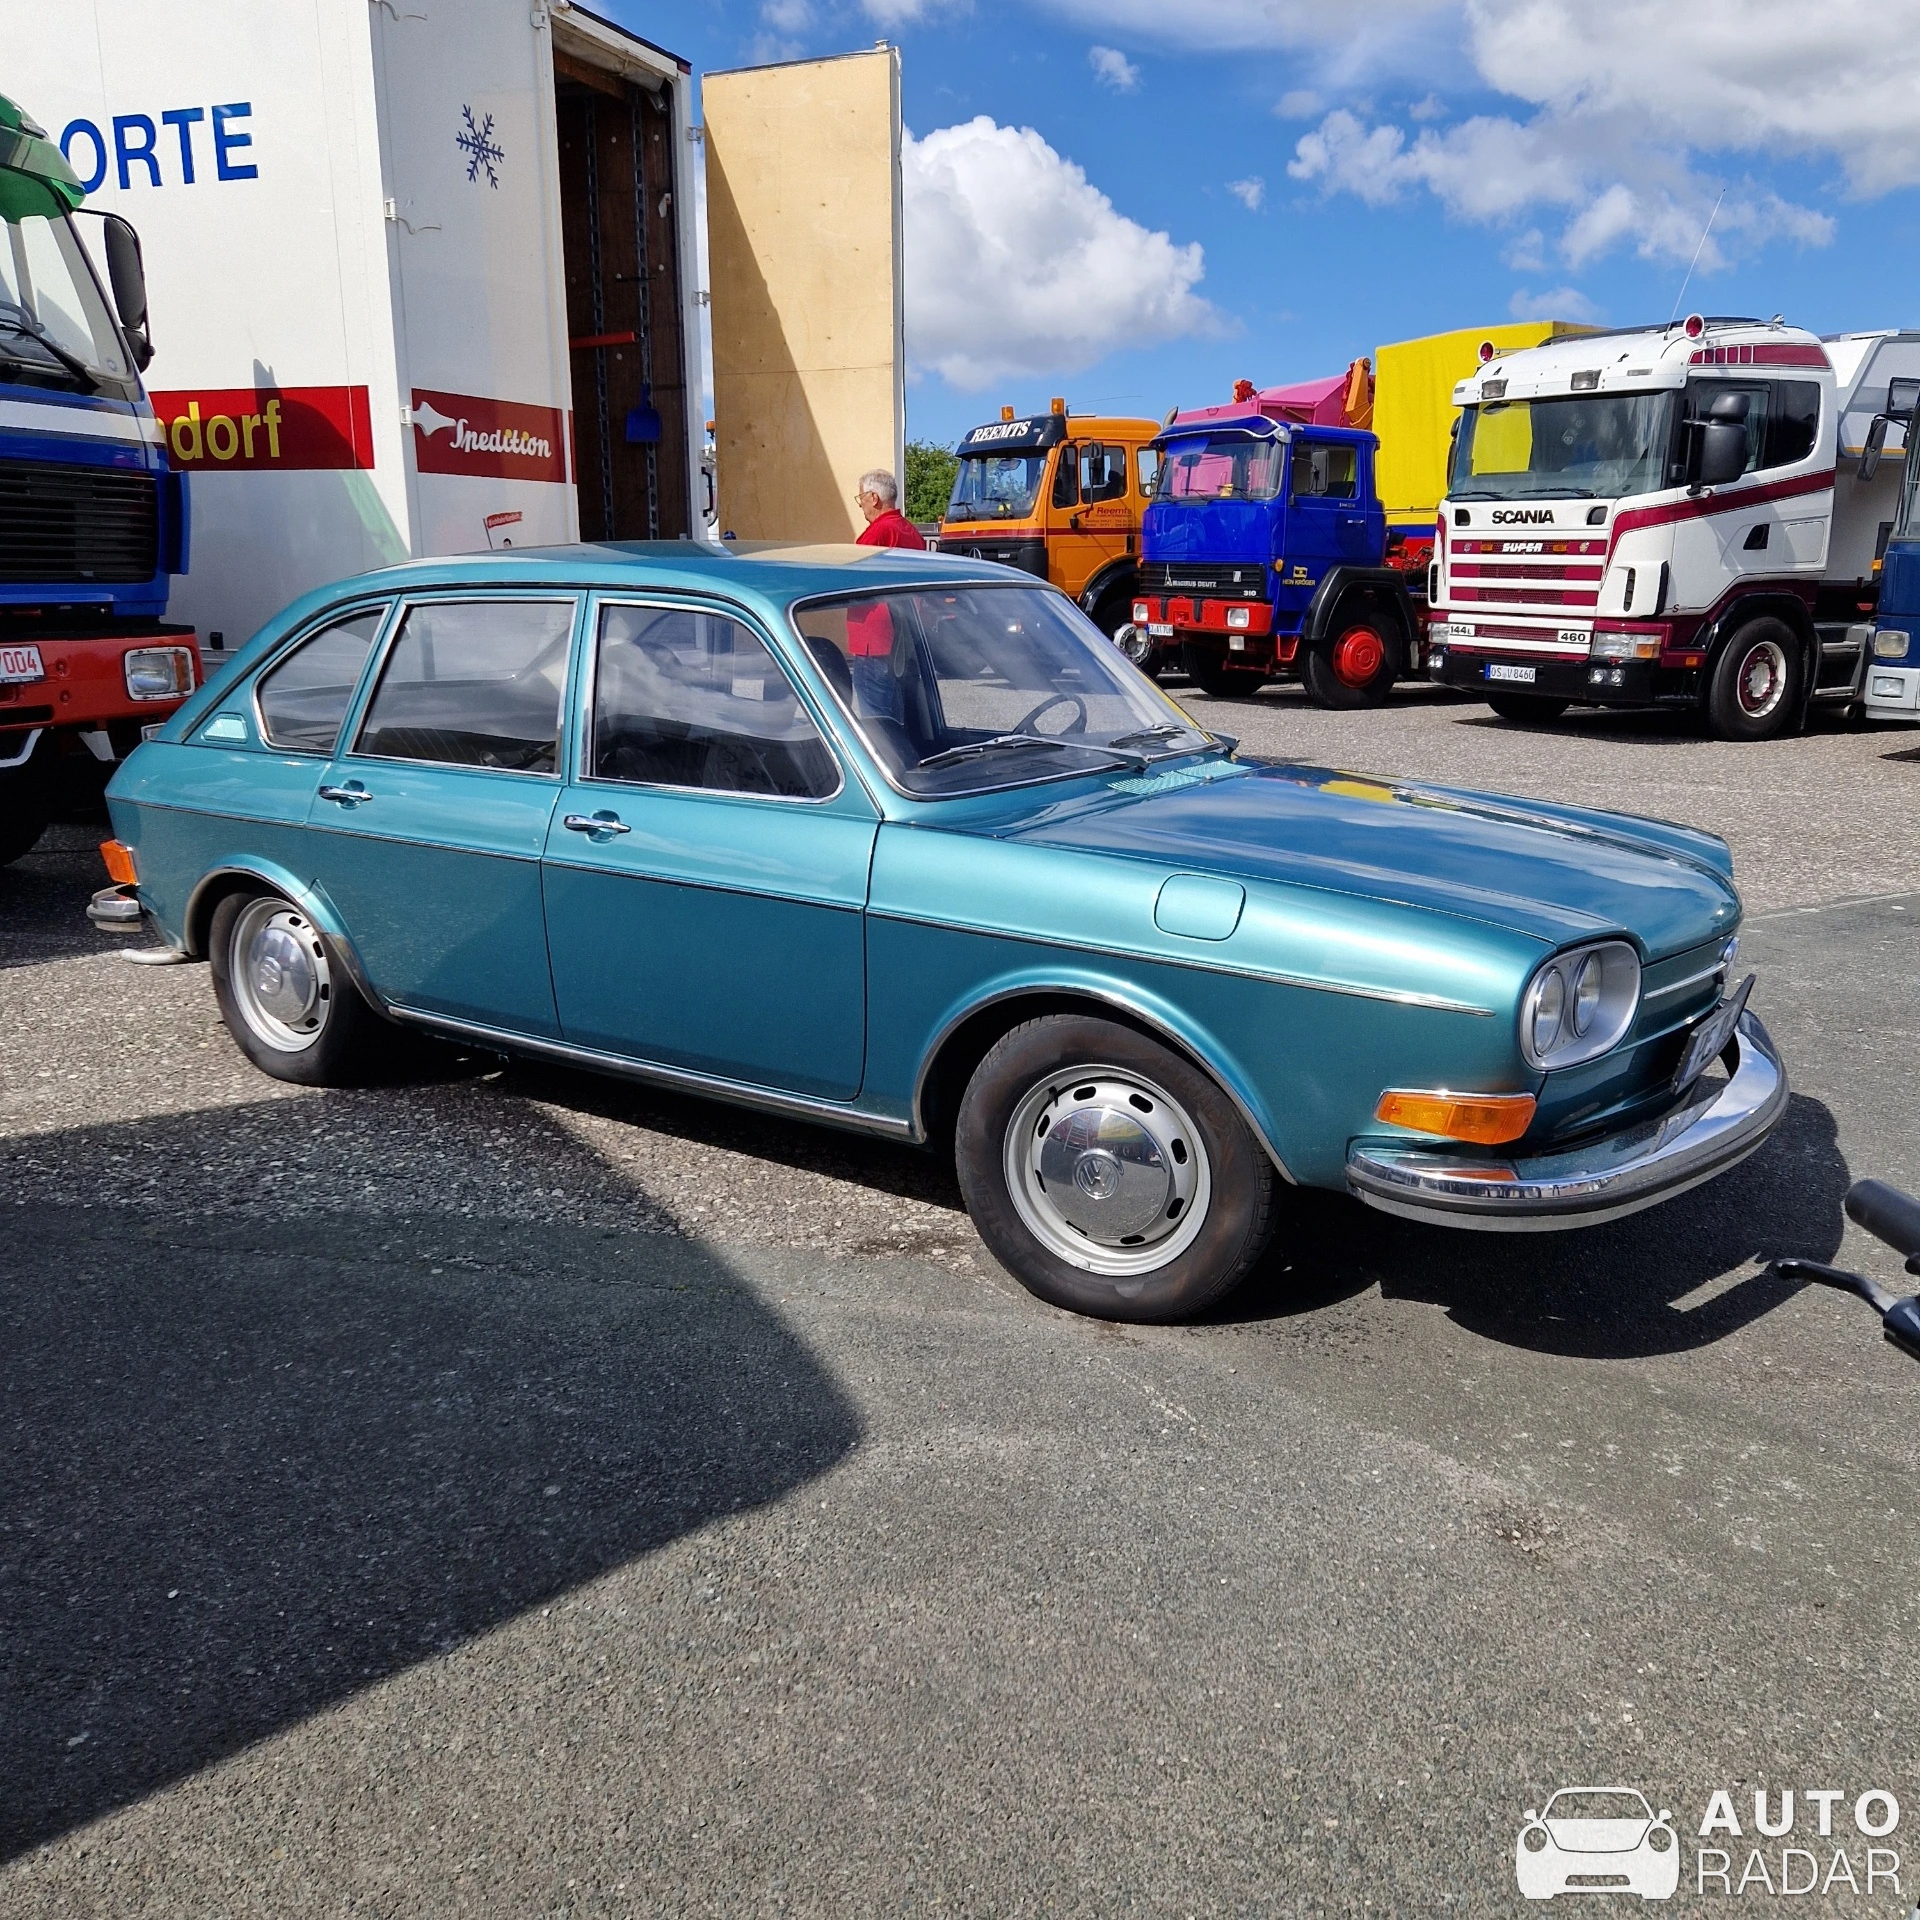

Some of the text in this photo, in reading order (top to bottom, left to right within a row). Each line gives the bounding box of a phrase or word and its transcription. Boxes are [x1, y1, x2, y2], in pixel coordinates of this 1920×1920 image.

[450, 418, 552, 458] Spedition
[969, 420, 1032, 444] REEMTS
[1096, 506, 1133, 515] Reemts
[1492, 509, 1555, 524] SCANIA
[1501, 542, 1543, 553] SUPER
[1560, 632, 1587, 643] 460
